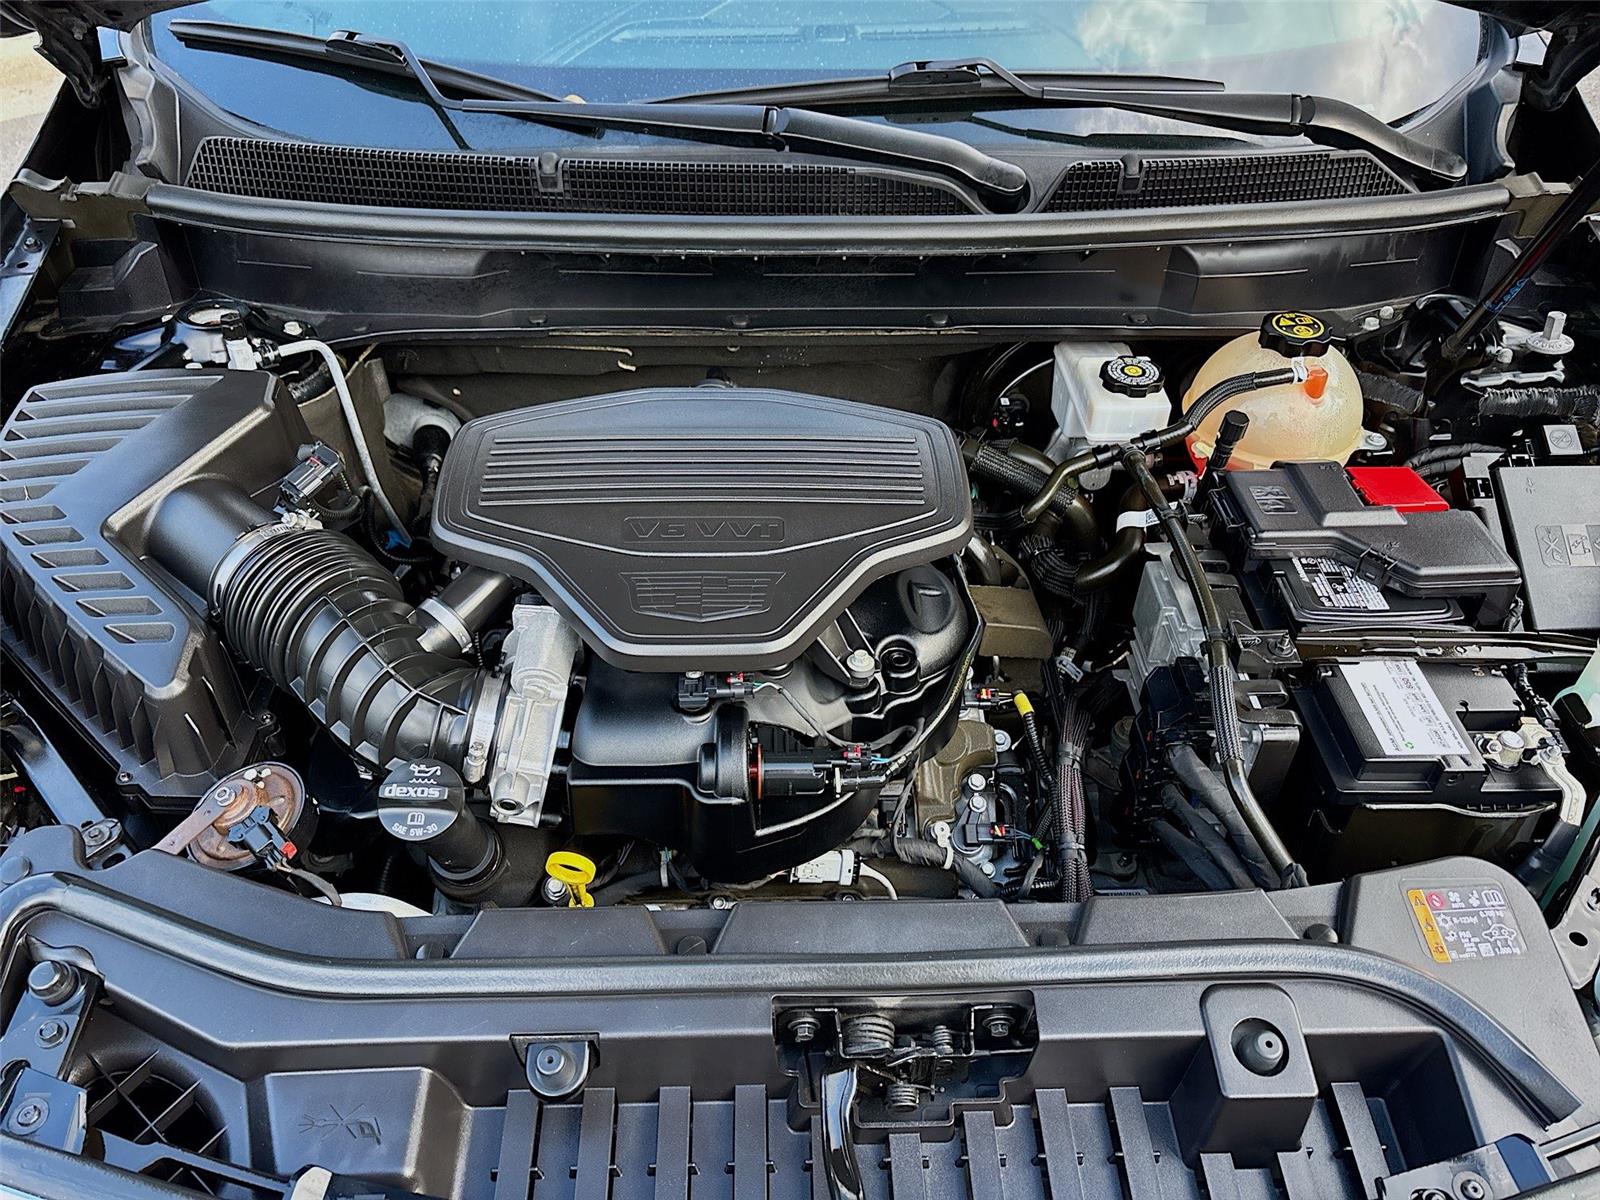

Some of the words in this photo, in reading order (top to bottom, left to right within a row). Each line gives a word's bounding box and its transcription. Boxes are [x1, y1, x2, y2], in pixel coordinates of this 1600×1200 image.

[384, 784, 440, 798] dexos
[392, 822, 408, 835] SAE
[409, 823, 438, 837] 5W-30
